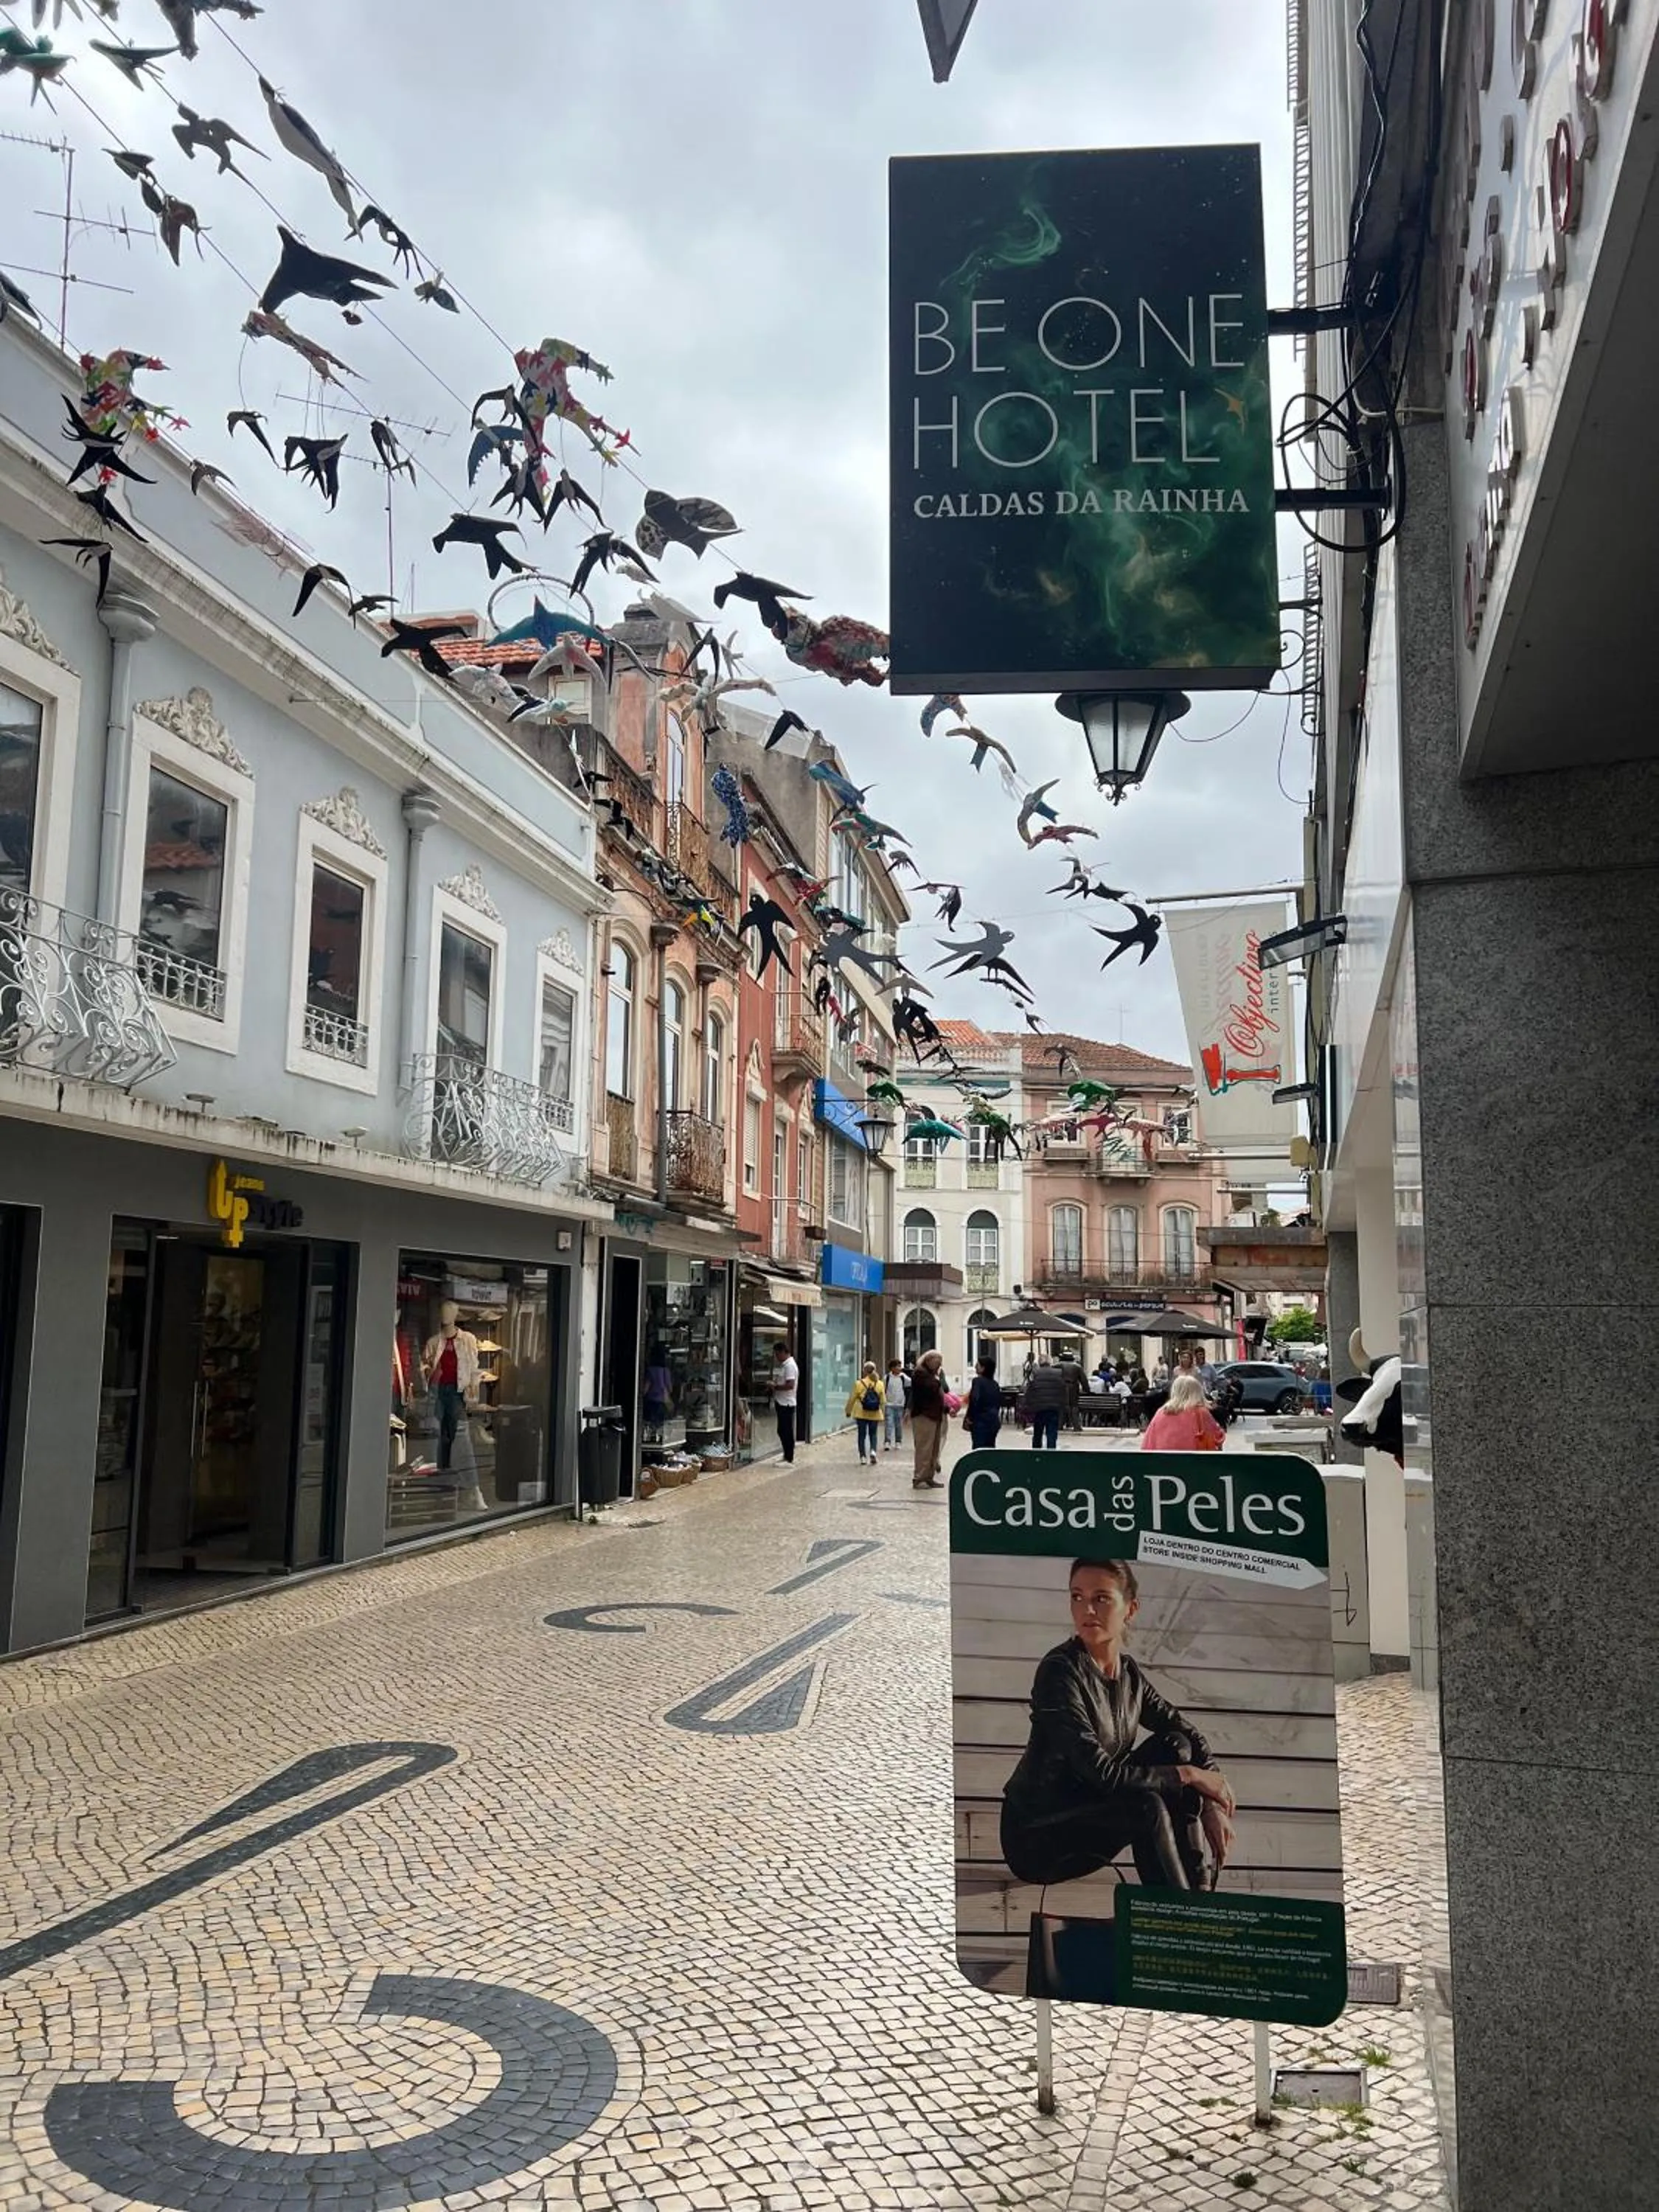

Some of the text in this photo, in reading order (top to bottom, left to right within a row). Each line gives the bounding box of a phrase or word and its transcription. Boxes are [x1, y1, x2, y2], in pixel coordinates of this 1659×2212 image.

[914, 294, 1245, 375] BE ONE
[914, 389, 1221, 470] HOTEL
[914, 488, 1251, 518] CALDAS DA RAINHA
[1225, 929, 1280, 1057] Objectivo
[1268, 931, 1279, 1014] inters
[963, 1470, 1306, 1536] Casa das Peles
[1143, 1545, 1267, 1573] STORE INSIDE SHOPPING MALL
[1144, 1537, 1301, 1571] LOJA DENTRO DO CENTRO COMERCIAL
